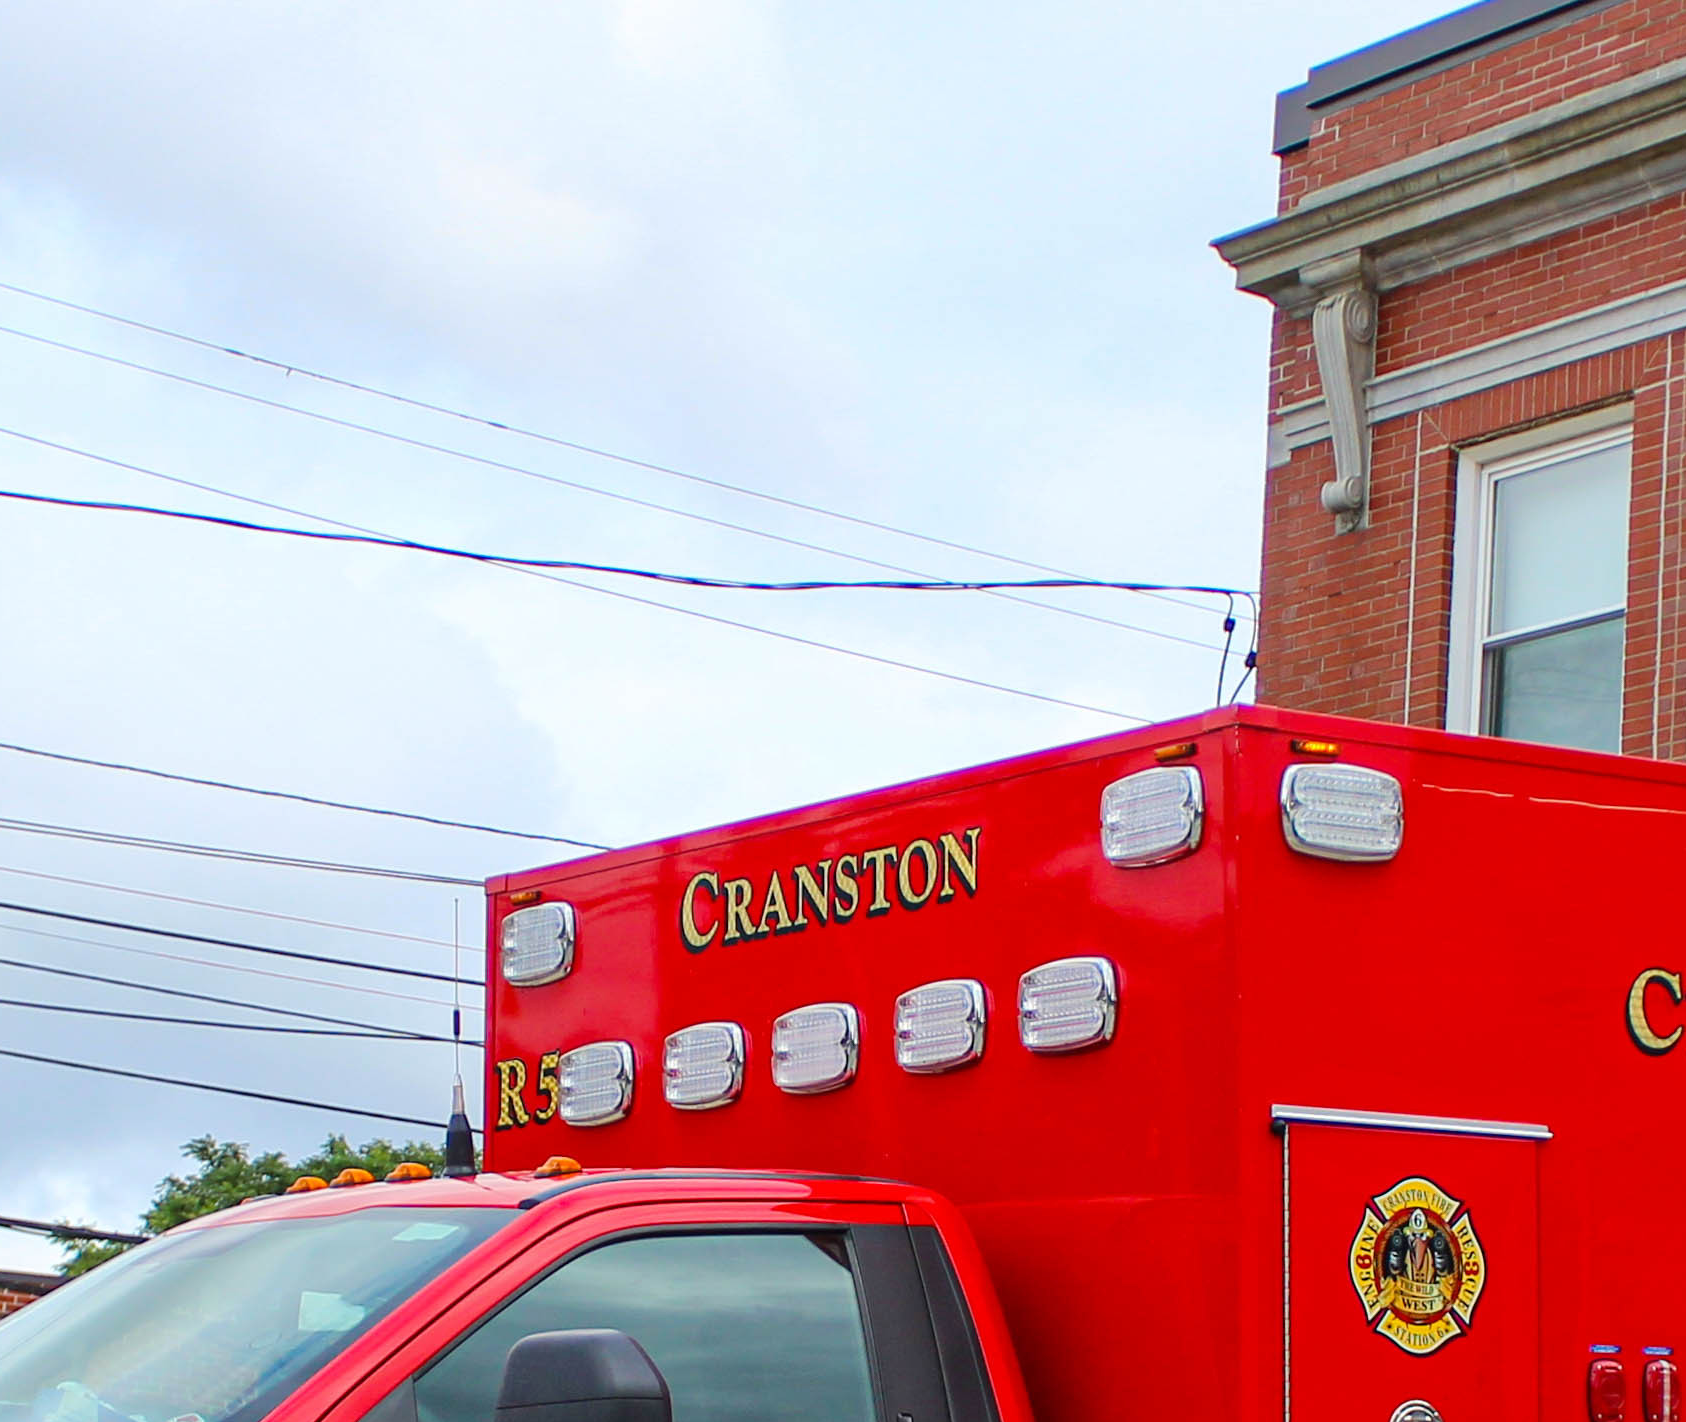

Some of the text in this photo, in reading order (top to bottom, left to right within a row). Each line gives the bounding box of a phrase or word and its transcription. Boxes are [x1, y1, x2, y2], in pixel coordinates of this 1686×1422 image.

[680, 827, 981, 953] CRANSTON
[1383, 1188, 1452, 1213] CRANSTON FIRE
[1414, 1213, 1423, 1228] 6
[1401, 1298, 1435, 1311] WEST
[1395, 1327, 1435, 1346] STATION
